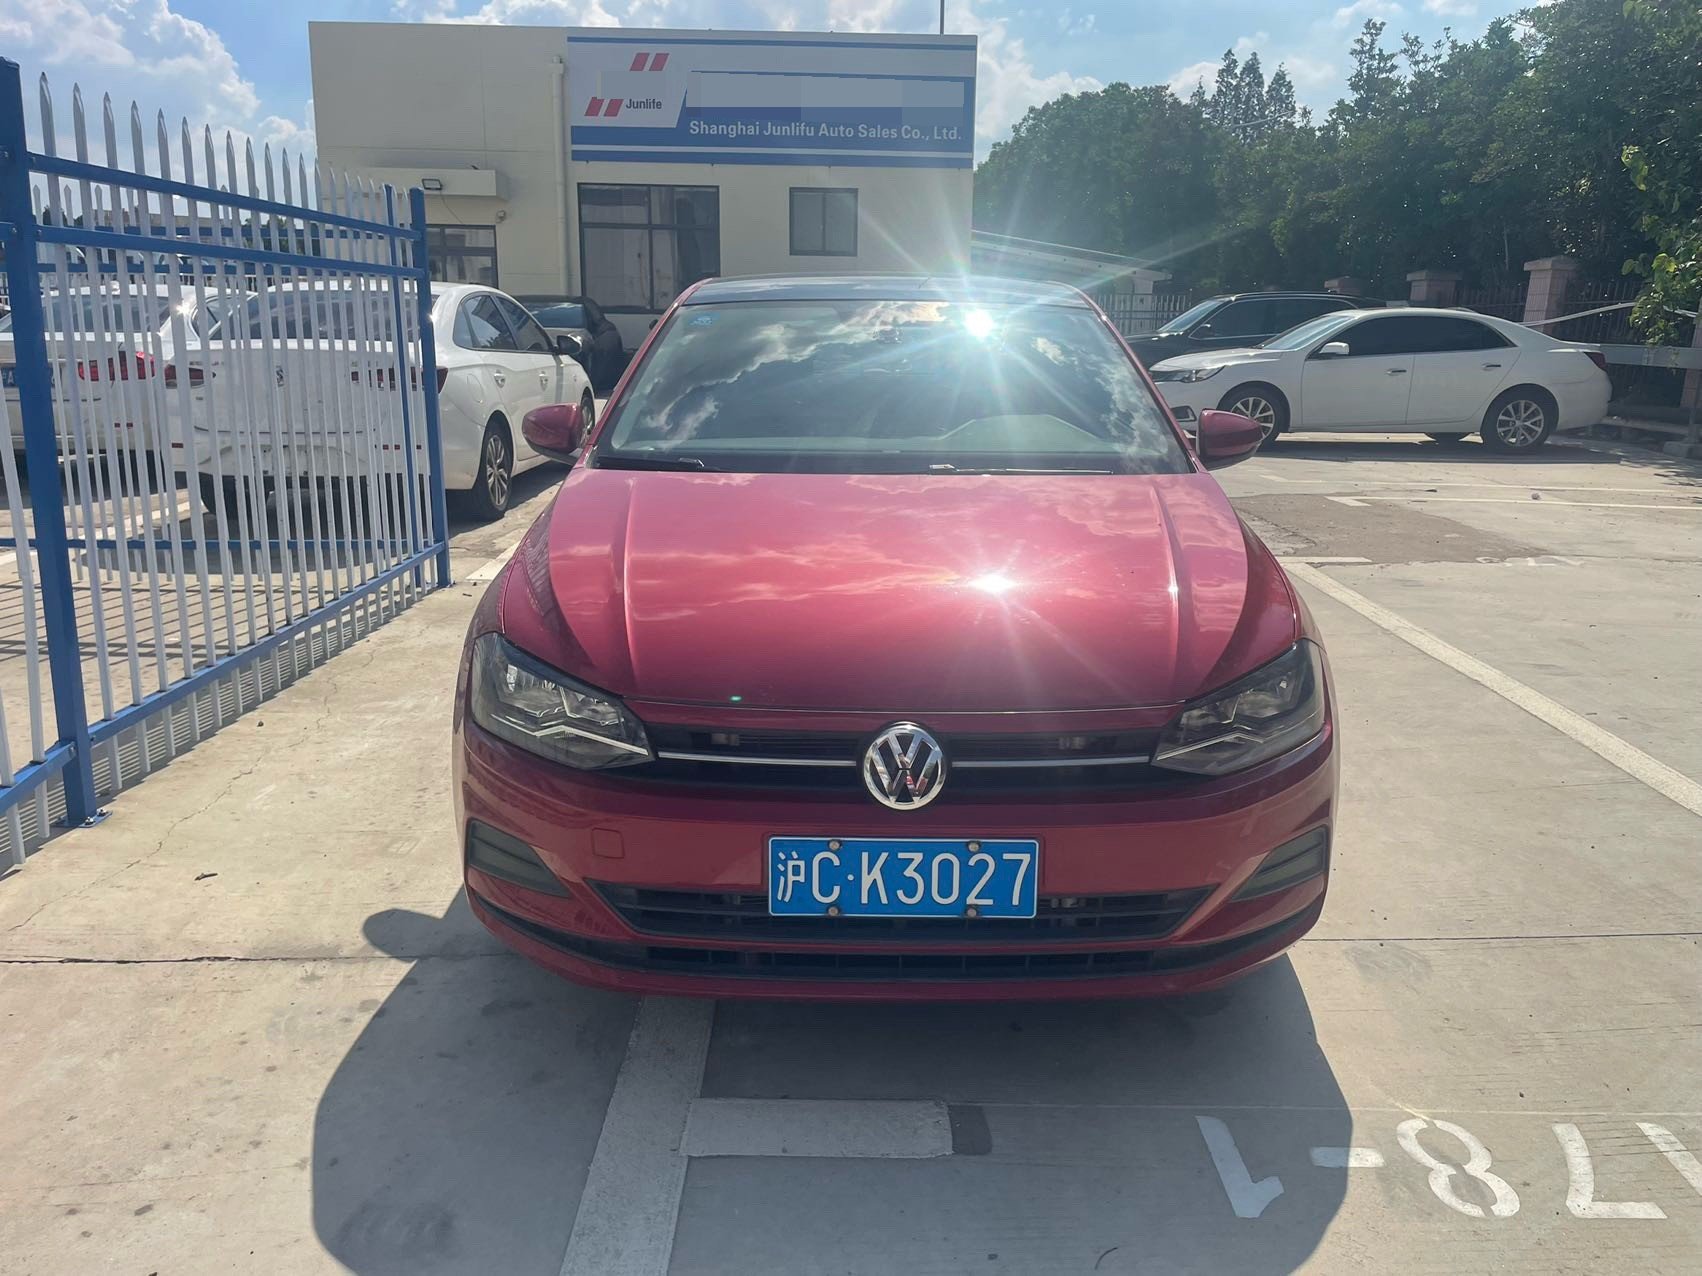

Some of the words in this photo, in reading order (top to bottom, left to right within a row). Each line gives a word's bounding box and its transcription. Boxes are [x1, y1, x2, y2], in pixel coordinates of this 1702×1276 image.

[625, 97, 663, 111] Junlife
[689, 120, 760, 138] Shanghai
[763, 121, 814, 137] Junlifu
[818, 123, 854, 138] Auto
[858, 124, 897, 139] Sales
[901, 125, 930, 141] Co.,
[934, 126, 962, 140] Ltd.
